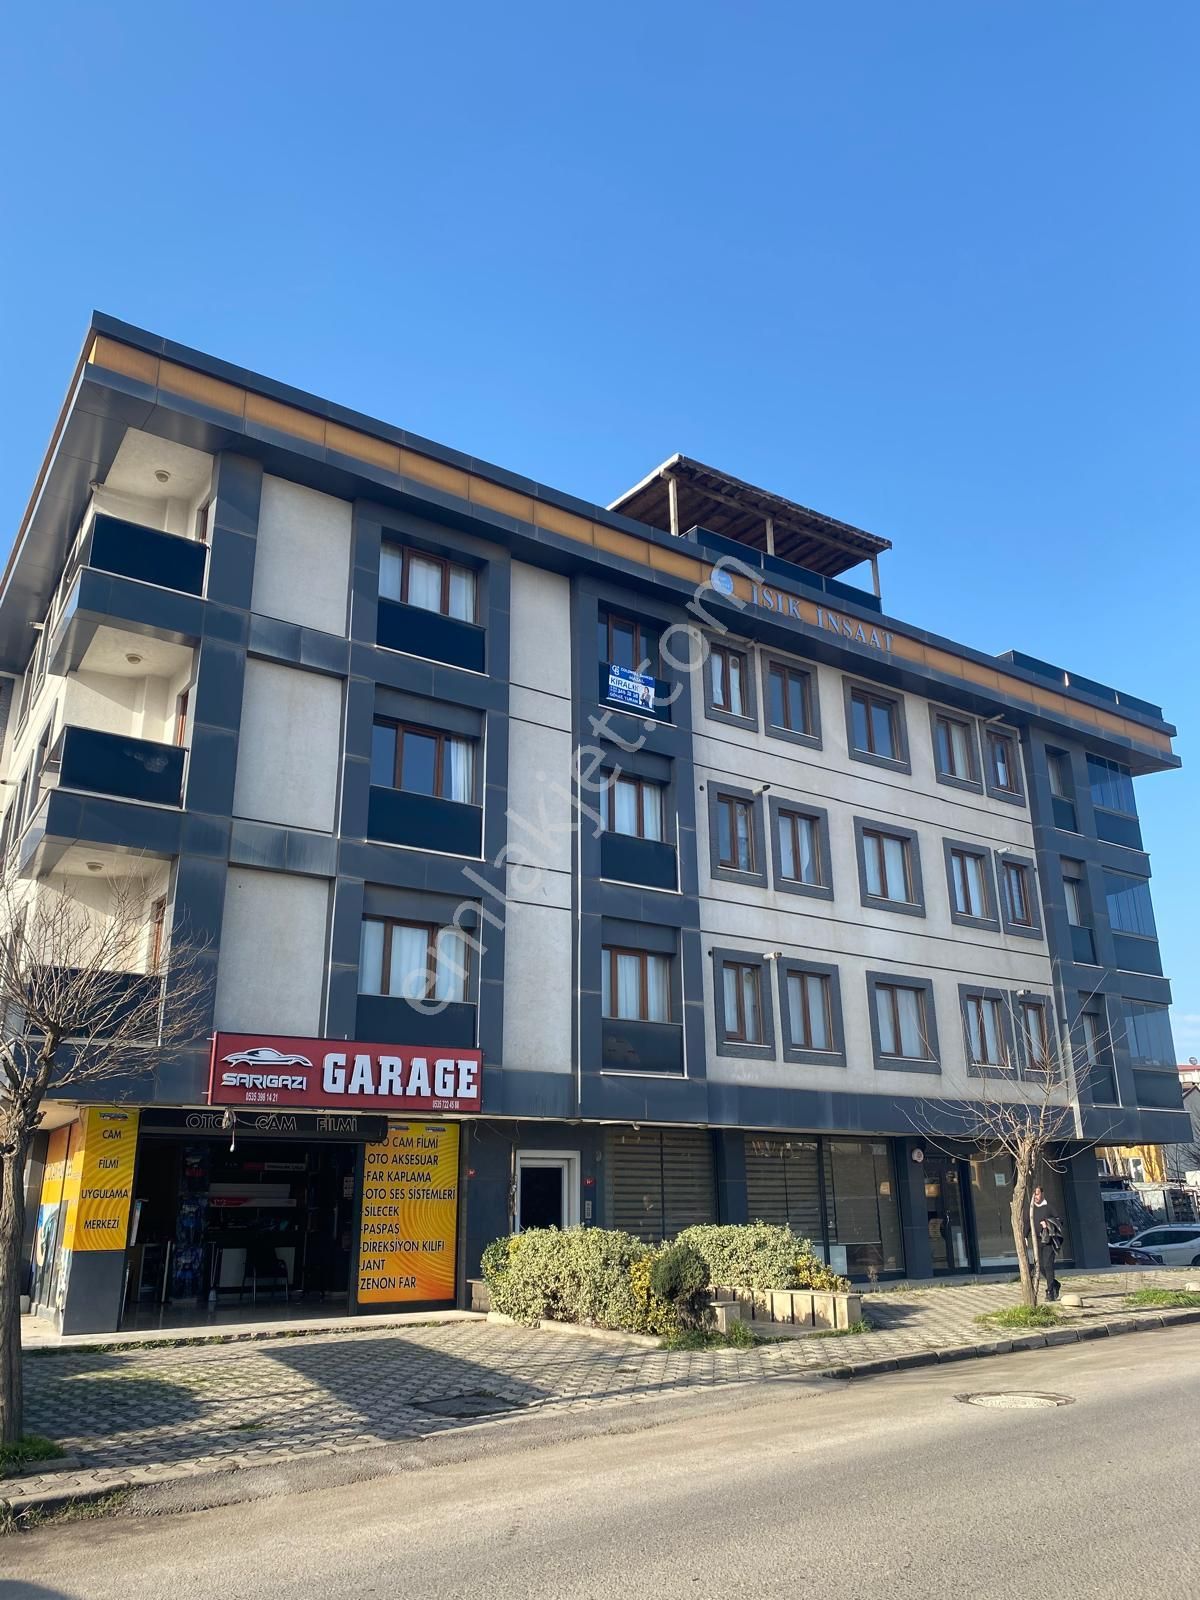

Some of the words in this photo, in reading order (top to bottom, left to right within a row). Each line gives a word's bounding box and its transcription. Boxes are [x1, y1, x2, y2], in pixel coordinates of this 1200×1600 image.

[323, 1053, 478, 1098] GARAGE
[102, 1129, 122, 1139] CAM
[392, 1137, 413, 1148] CAM
[416, 1134, 439, 1149] FİLMİ
[391, 1154, 439, 1166] AKSESUAR
[387, 1171, 432, 1183] KAPLAMA
[81, 1188, 129, 1199] UYGULAMA
[389, 1188, 405, 1200] SES
[408, 1185, 455, 1200] SİSTEMLERİ
[84, 1215, 120, 1229] MERKEZİ
[398, 1276, 416, 1289] FAR
